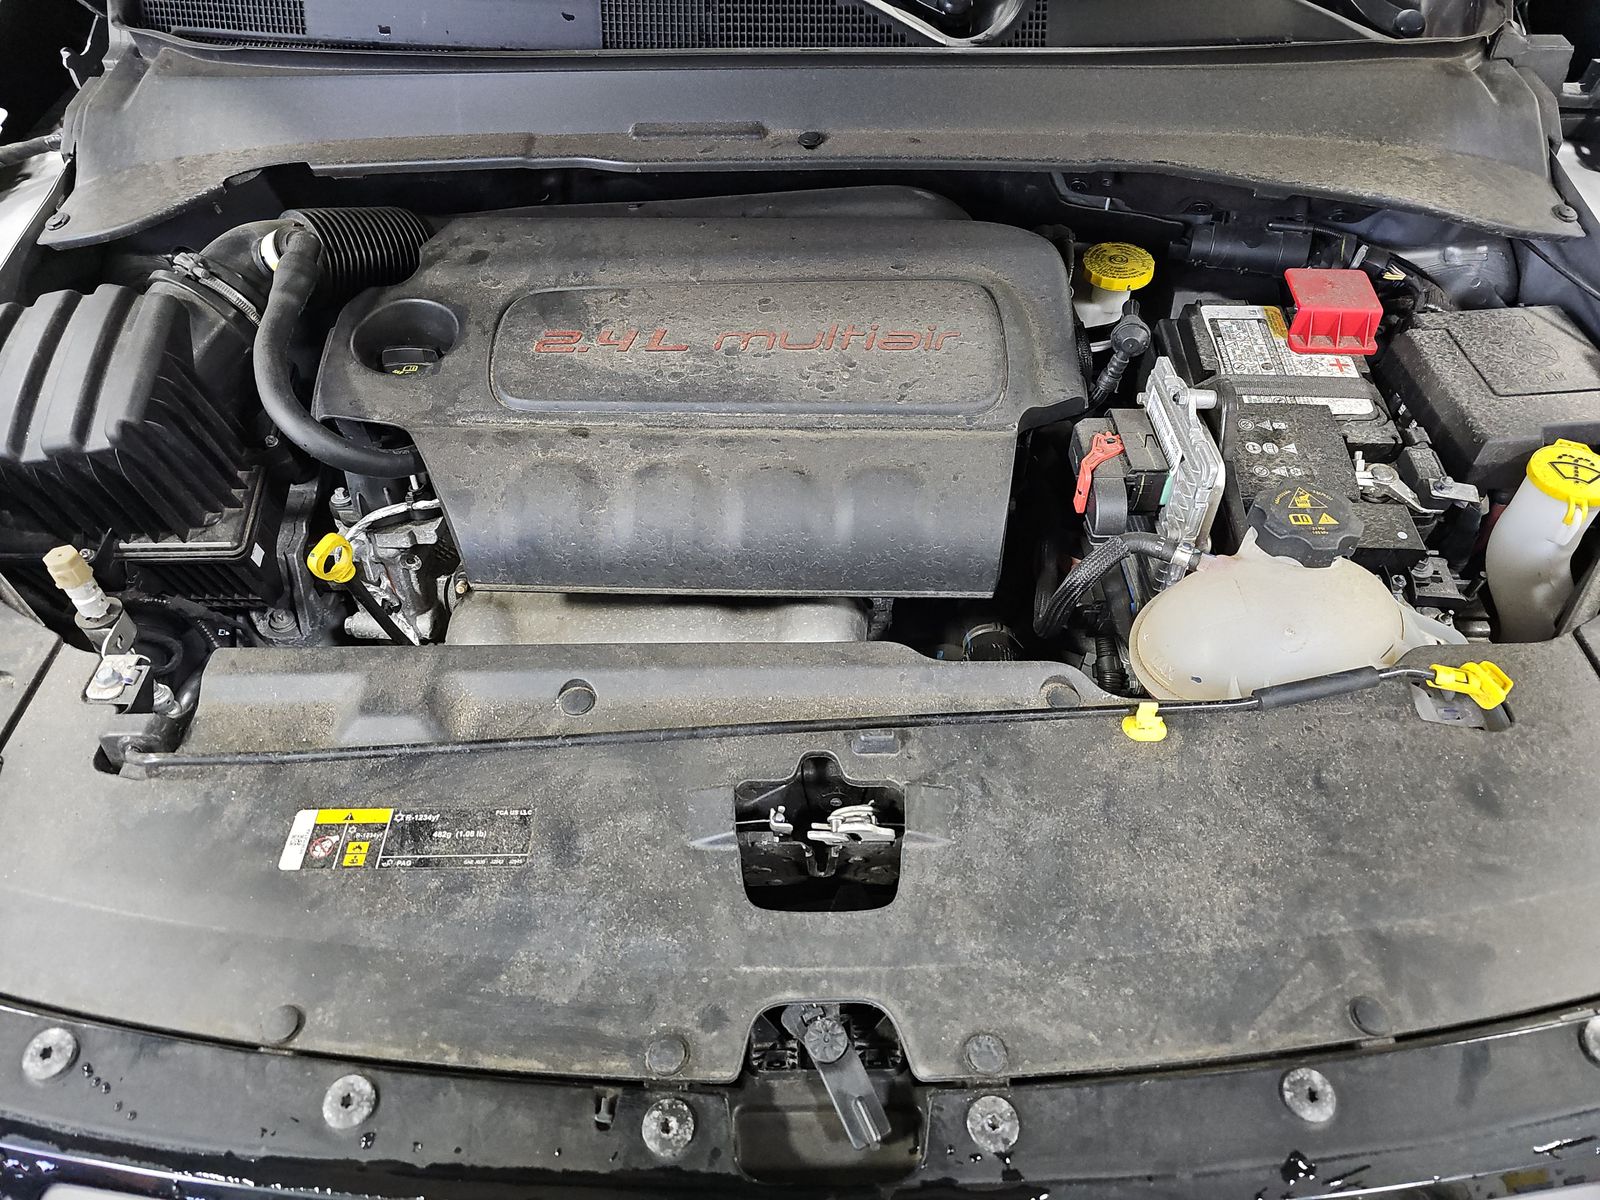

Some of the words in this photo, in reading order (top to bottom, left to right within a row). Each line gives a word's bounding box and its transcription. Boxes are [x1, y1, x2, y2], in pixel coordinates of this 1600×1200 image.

[714, 323, 963, 352] multiair
[405, 813, 441, 823] R-1234yf
[476, 830, 487, 840] lb)
[396, 859, 412, 867] PAG
